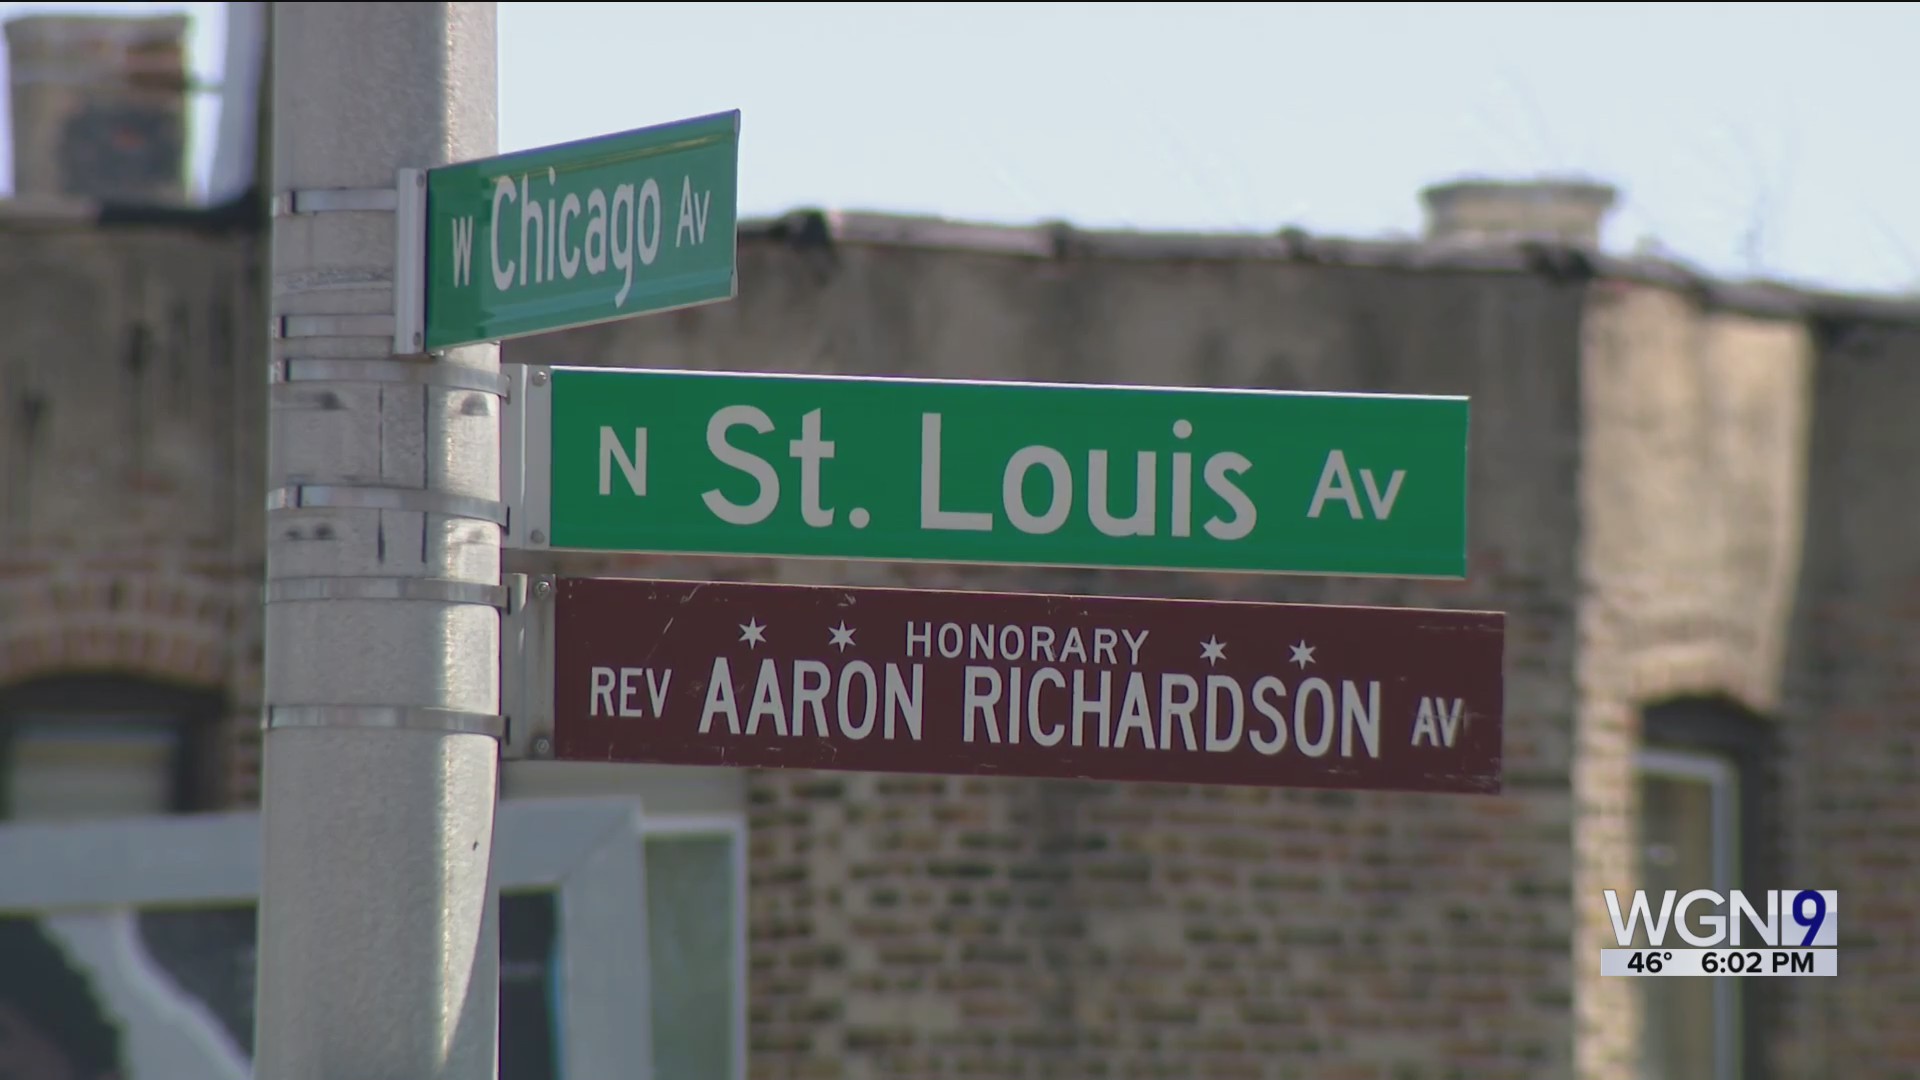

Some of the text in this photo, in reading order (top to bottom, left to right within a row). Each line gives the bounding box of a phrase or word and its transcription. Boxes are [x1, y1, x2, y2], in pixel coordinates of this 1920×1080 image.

[452, 167, 711, 308] W Chicago Av
[599, 405, 1407, 540] N St. Louis Av
[906, 621, 1149, 665] HONORARY
[590, 666, 672, 718] REV
[698, 656, 924, 741] AARON
[963, 666, 1381, 758] RICHARDSON
